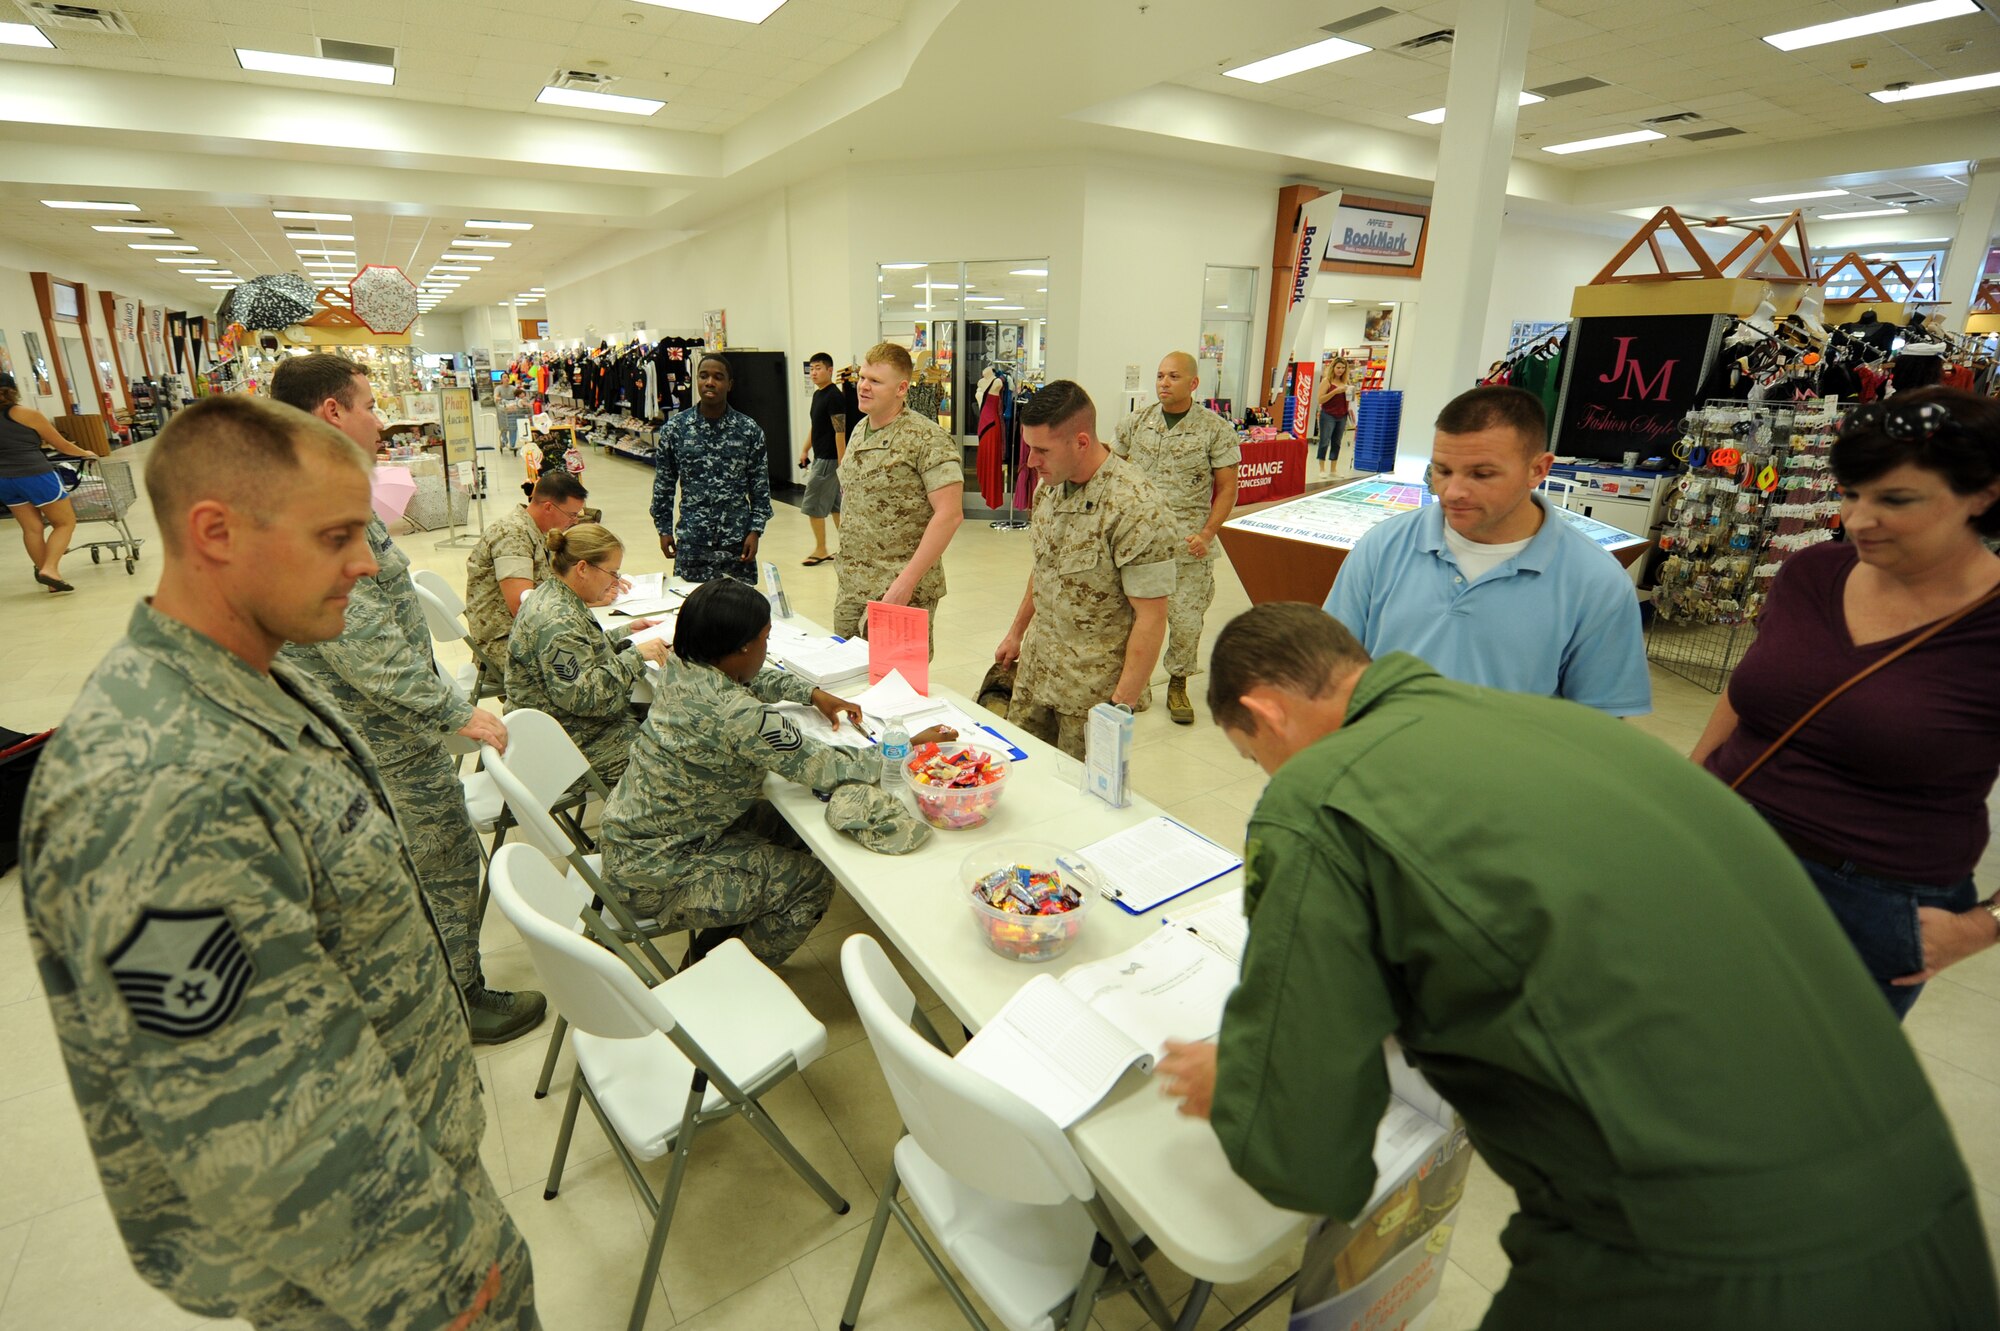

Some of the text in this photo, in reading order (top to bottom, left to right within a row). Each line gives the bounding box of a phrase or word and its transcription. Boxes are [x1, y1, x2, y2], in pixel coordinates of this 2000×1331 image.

[1343, 226, 1407, 251] BookMark
[1293, 226, 1317, 303] BookMark
[1599, 336, 1680, 402] JM
[1577, 402, 1676, 441] Fashion Style
[1239, 519, 1352, 544] WELCOME TO THE KADENA
